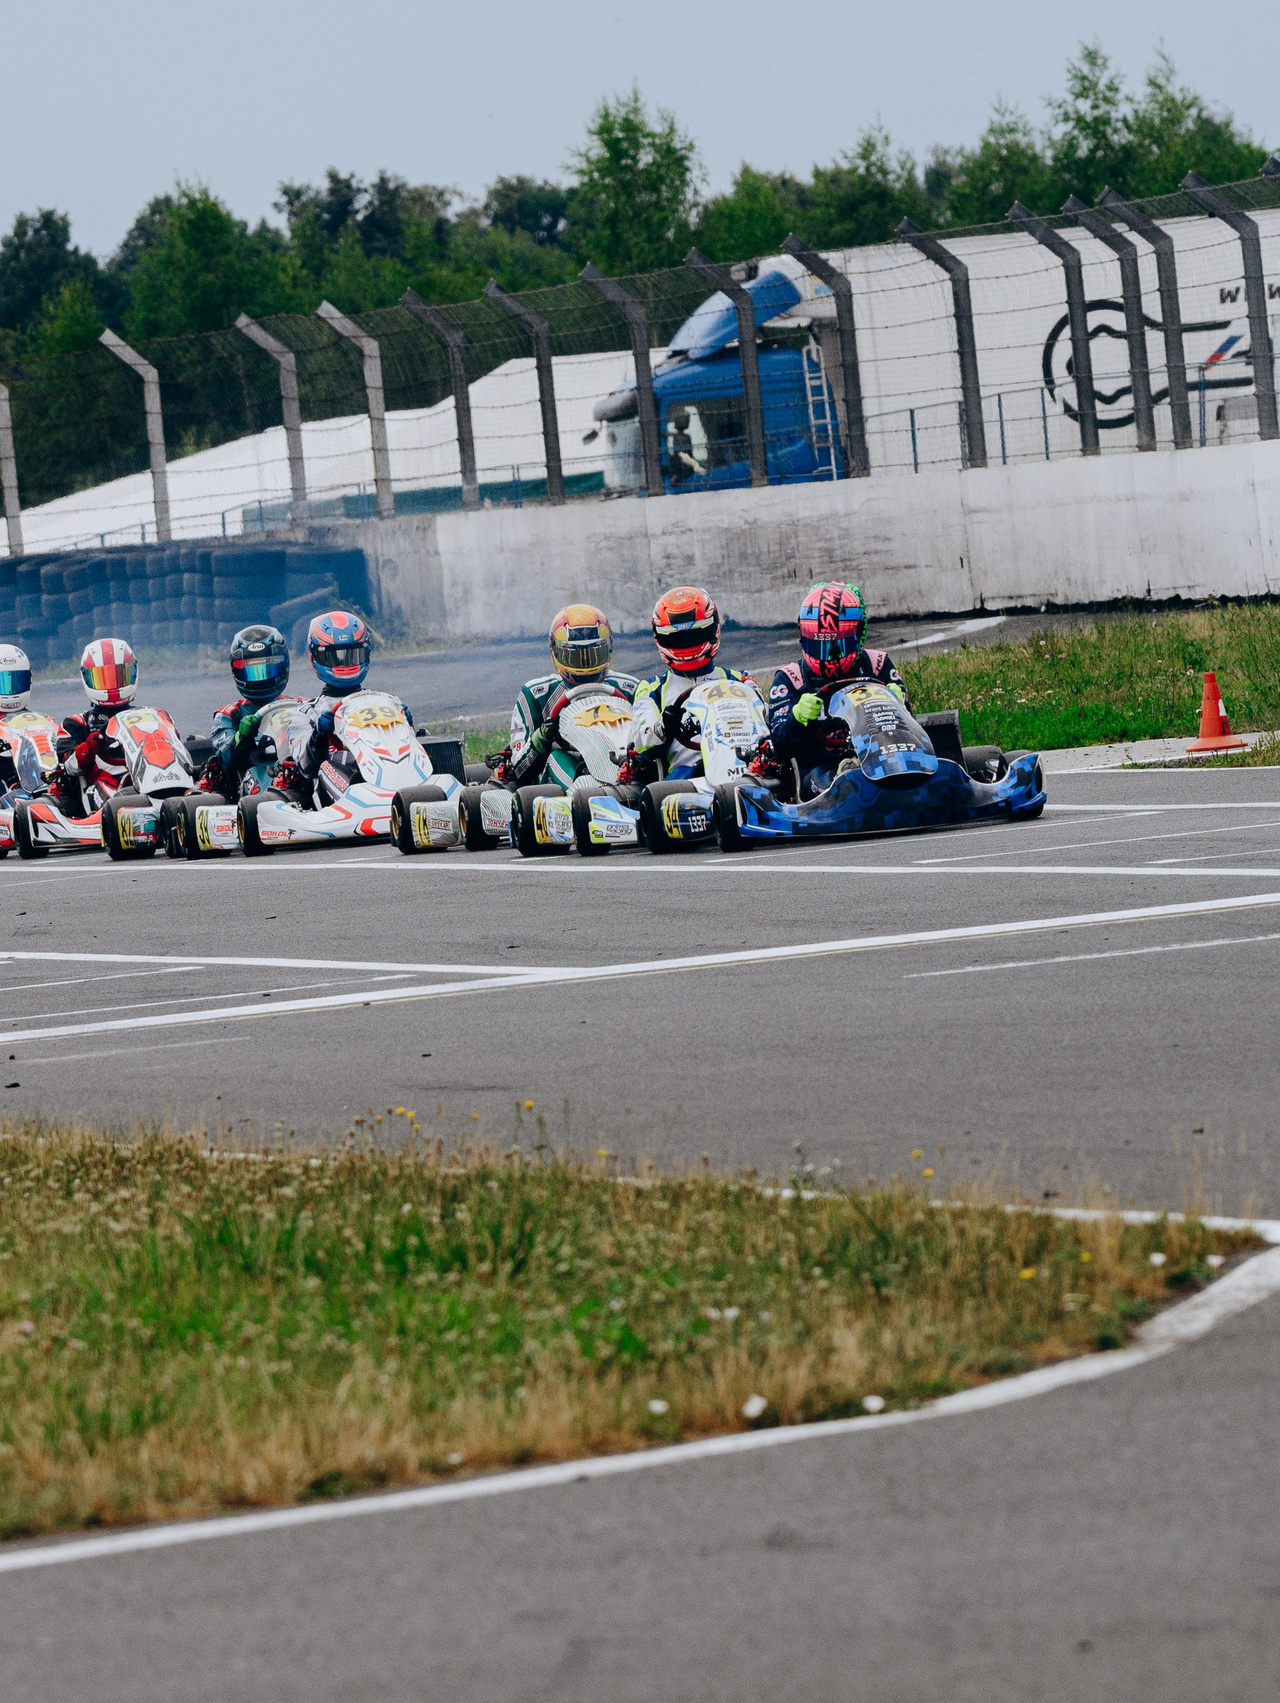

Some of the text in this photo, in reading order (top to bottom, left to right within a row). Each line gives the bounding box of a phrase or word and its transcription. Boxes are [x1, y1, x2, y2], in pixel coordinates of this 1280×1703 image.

[813, 632, 838, 641] 1337
[707, 684, 748, 699] 46
[359, 706, 397, 722] 39
[879, 743, 917, 755] 1337
[216, 825, 234, 834] SOKOL
[687, 814, 707, 833] 1337
[260, 830, 291, 839] SOKOL
